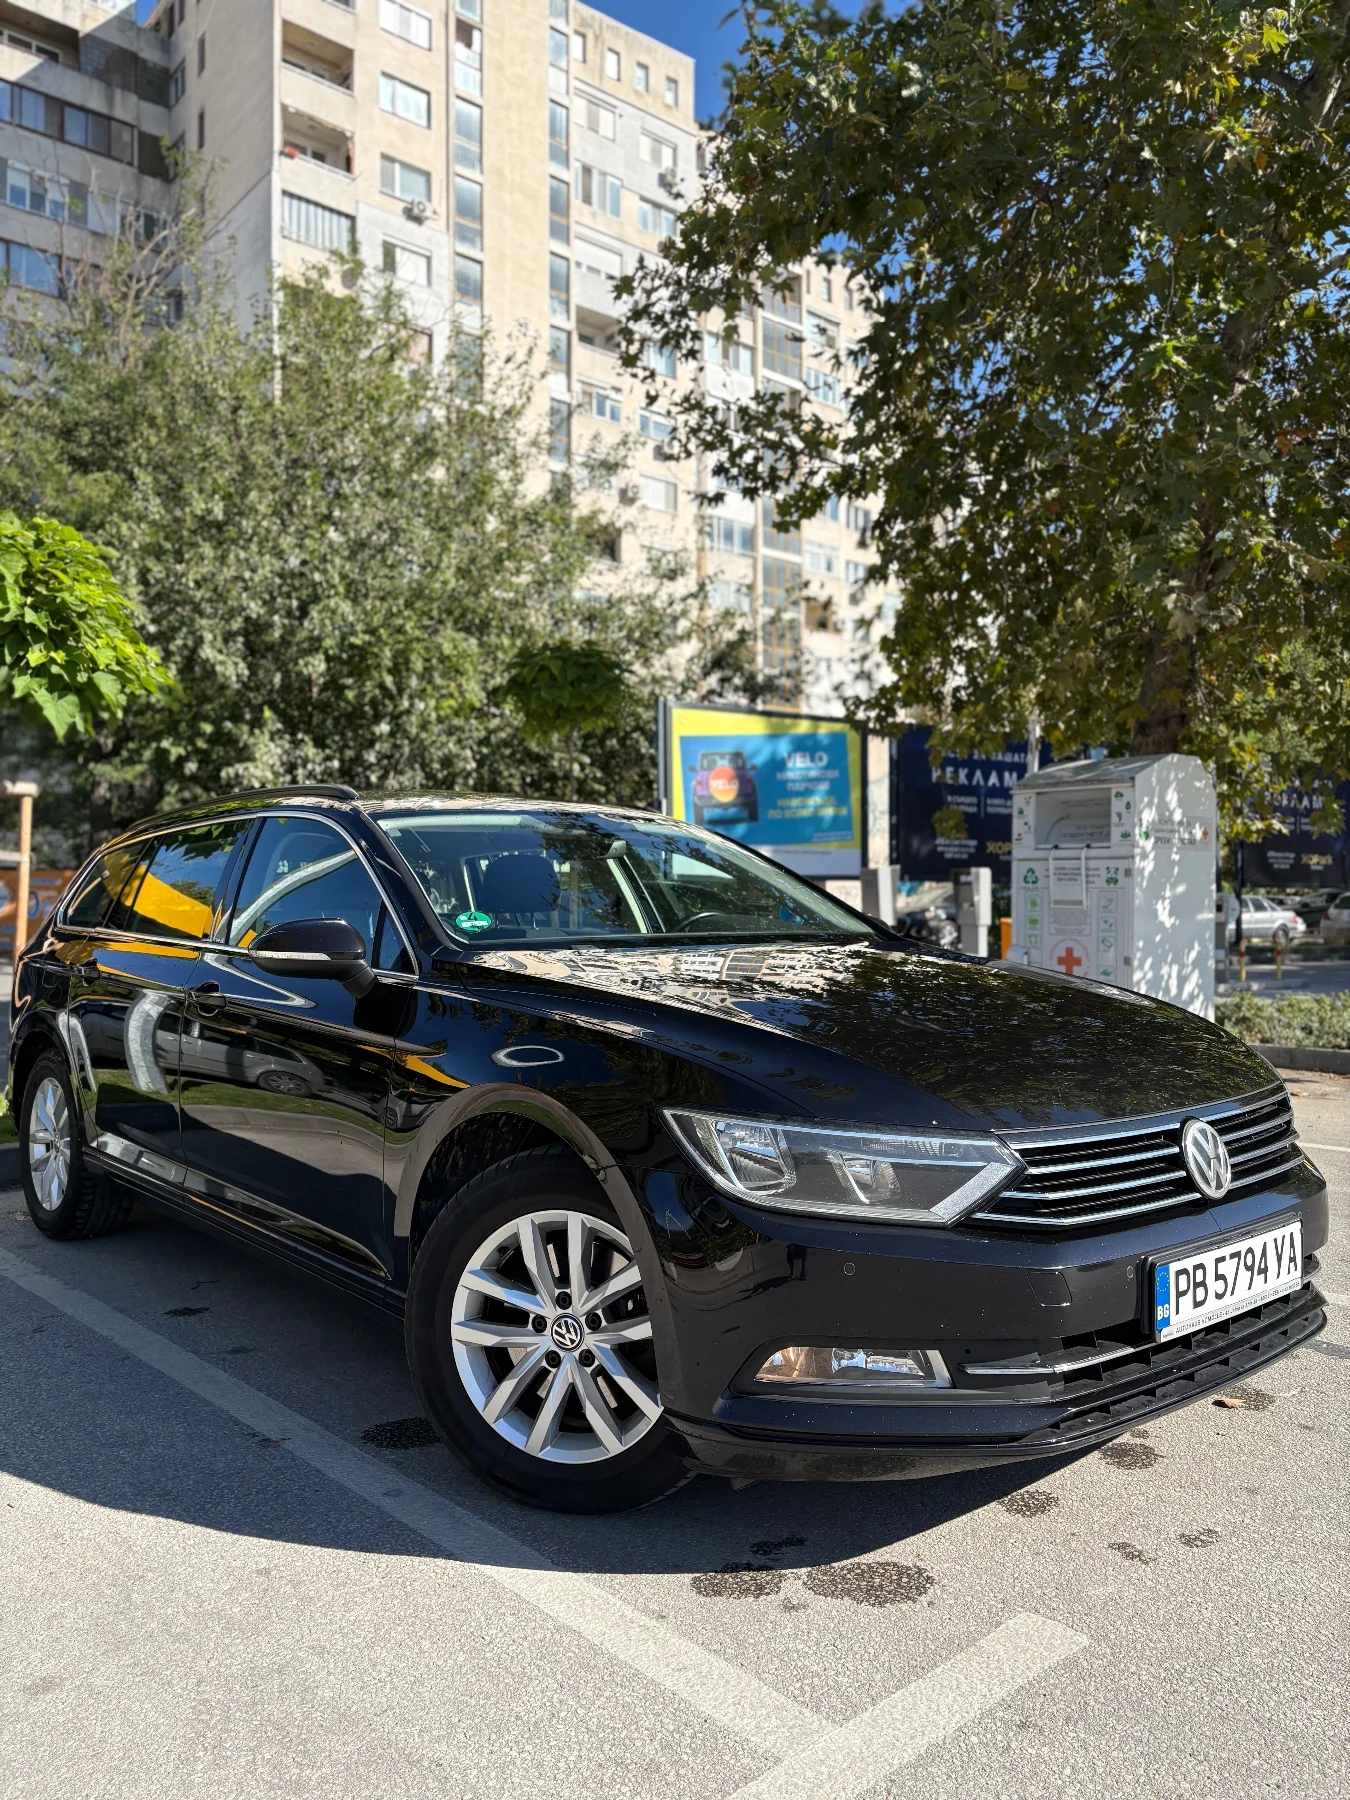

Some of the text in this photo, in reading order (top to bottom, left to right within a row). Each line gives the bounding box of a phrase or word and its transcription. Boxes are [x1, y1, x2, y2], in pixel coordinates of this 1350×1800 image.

[784, 752, 828, 768] VELO
[711, 778, 740, 790] VELO
[932, 766, 1020, 788] РЕКЛАМ
[1175, 1262, 1209, 1316] PB
[1214, 1241, 1269, 1300] 5794
[1273, 1231, 1298, 1280] YA
[1157, 1303, 1169, 1320] BG
